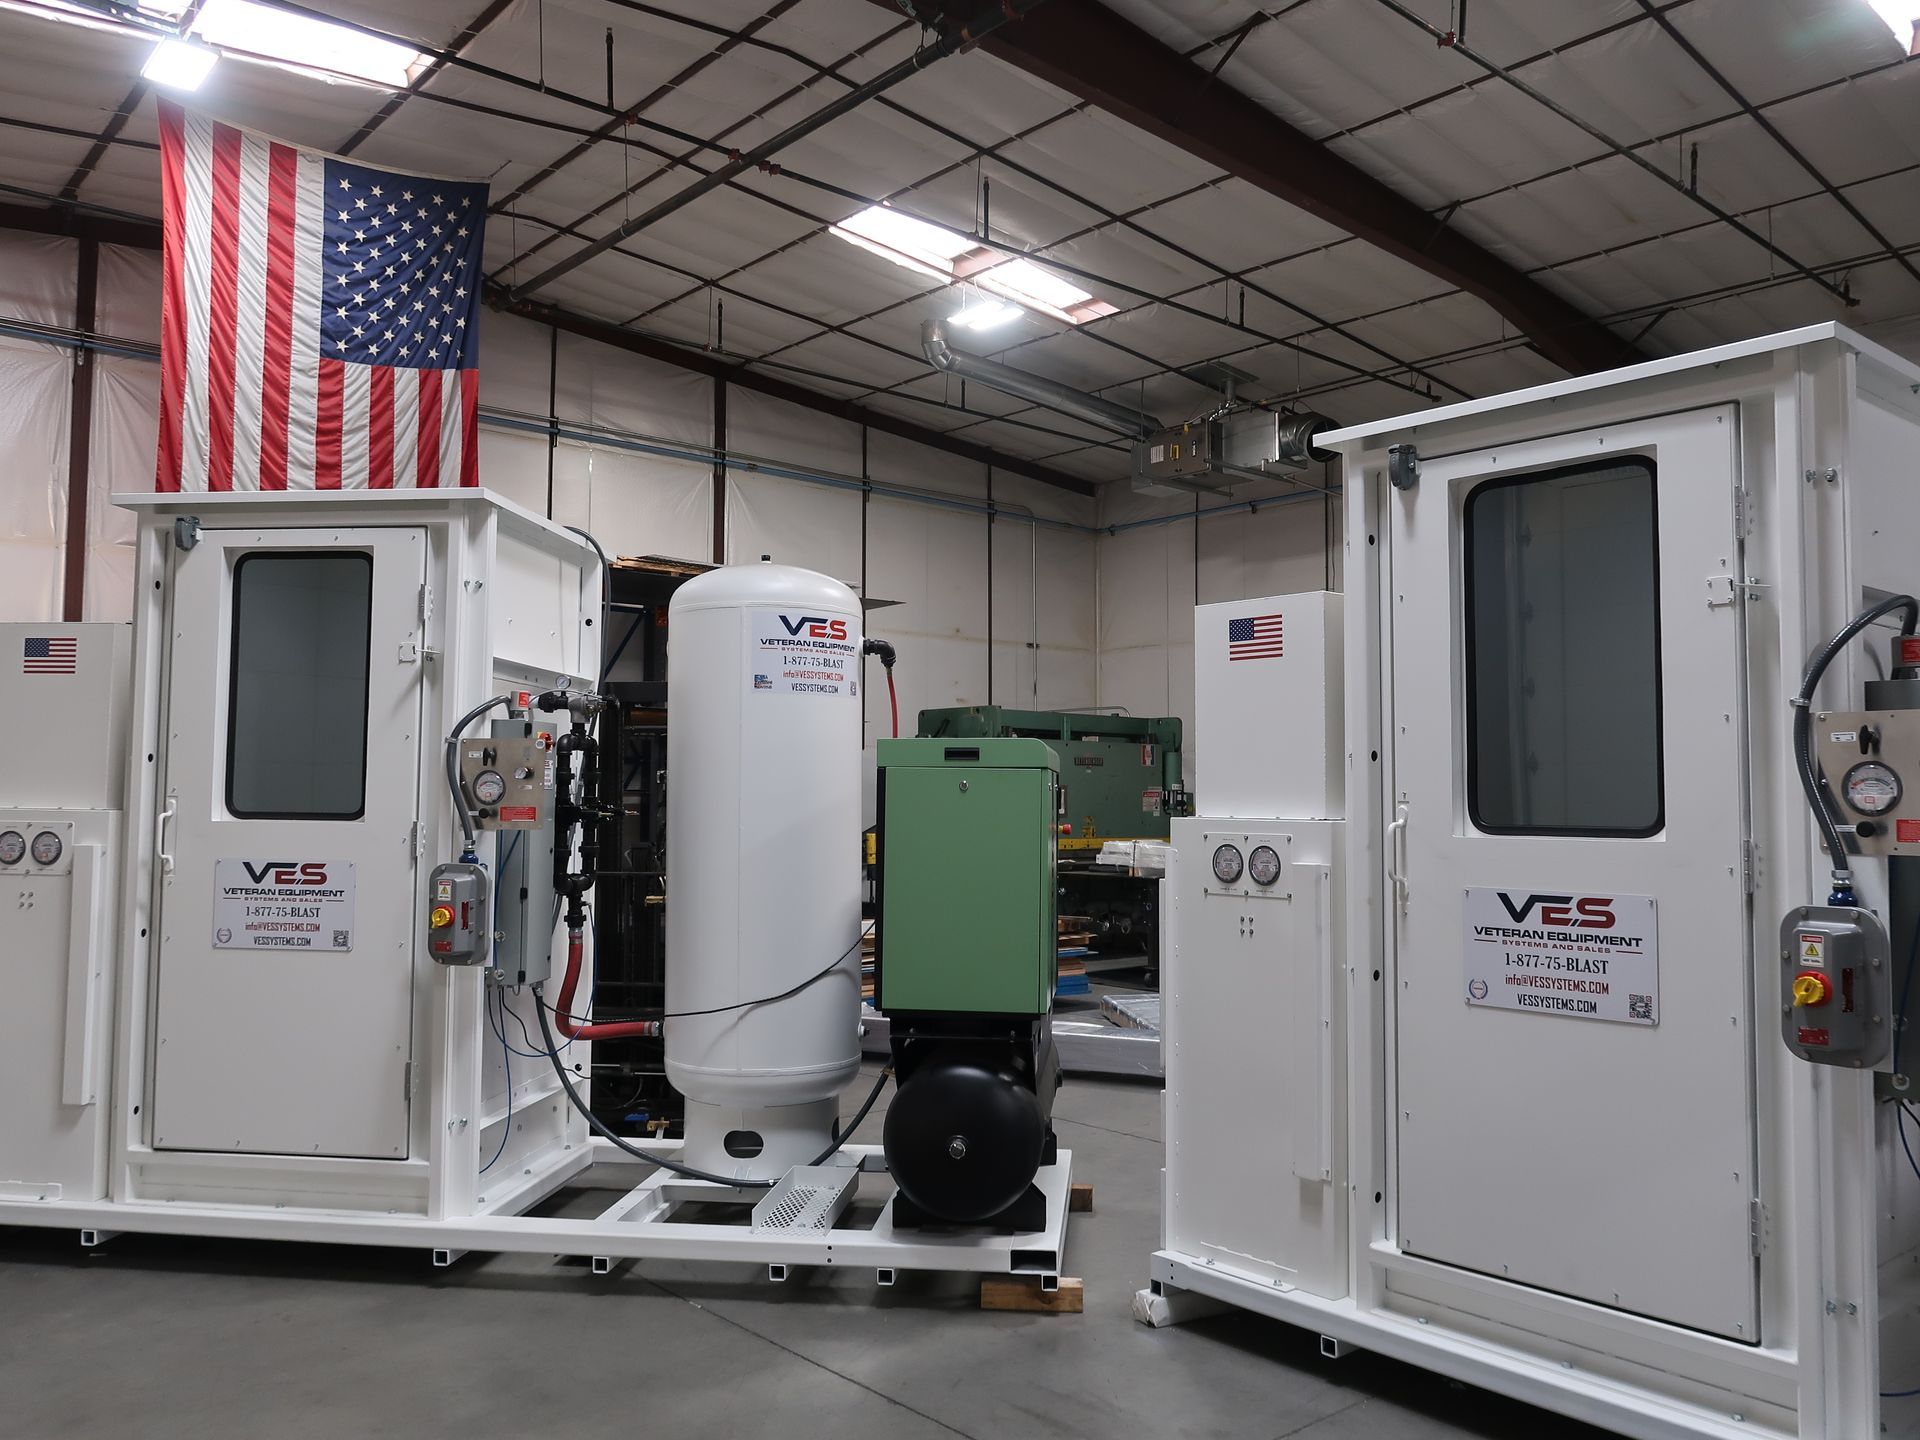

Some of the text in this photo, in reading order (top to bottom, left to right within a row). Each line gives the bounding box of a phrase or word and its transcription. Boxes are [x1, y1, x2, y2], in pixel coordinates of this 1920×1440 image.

[778, 615, 847, 641] VES
[760, 638, 855, 652] VETERAN EQUIPMENT
[783, 655, 844, 669] 1-877-75-BLAST
[783, 670, 844, 682] info@VESSYSTEMS.COM
[791, 683, 839, 694] VESSYSTEMS.COM
[242, 861, 328, 885] VES
[223, 888, 345, 897] VETERAN EQUIPMENT
[245, 906, 320, 918] 1-877-75-BLAST
[1496, 892, 1616, 929] VES
[245, 921, 320, 932] info@VESSYSTEMS.COM
[253, 936, 311, 947] VESSYSTEMS.COM
[1474, 926, 1643, 947] VETERAN EQUIPMENT
[1502, 939, 1611, 954] SYSTEMS AND SALES
[1505, 953, 1609, 975] 1-877-75-BLAST
[1505, 974, 1609, 995] info@VESSYSTEMS.COM
[1517, 993, 1597, 1014] VESSYSTEMS.COM
